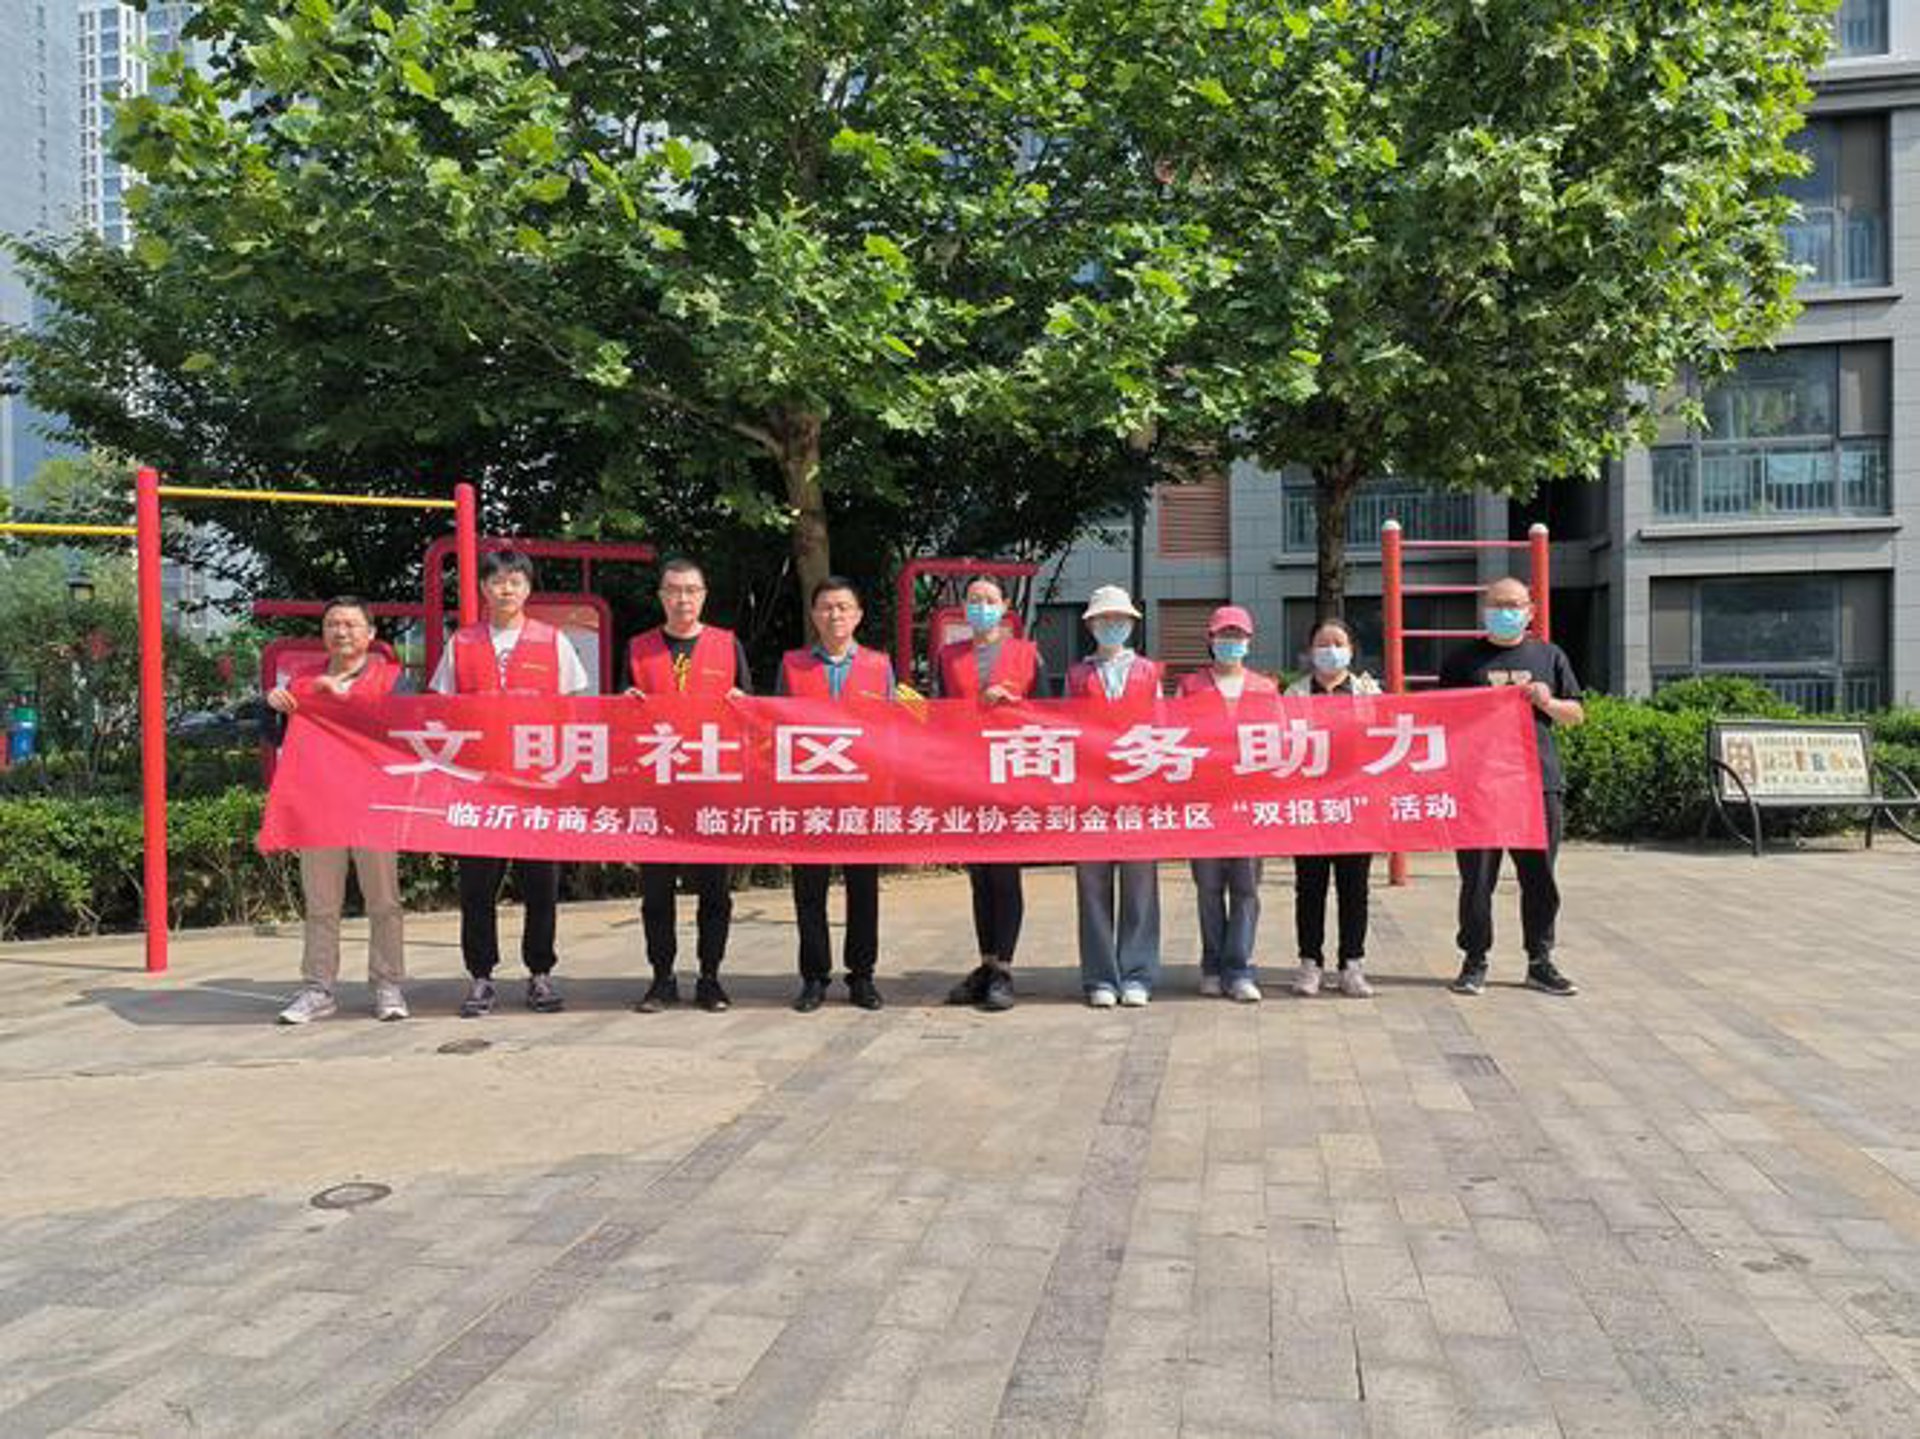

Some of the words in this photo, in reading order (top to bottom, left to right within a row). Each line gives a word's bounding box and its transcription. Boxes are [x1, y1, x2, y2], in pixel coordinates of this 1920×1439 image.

[382, 720, 869, 785] 文明社区
[981, 713, 1450, 785] 商务助力
